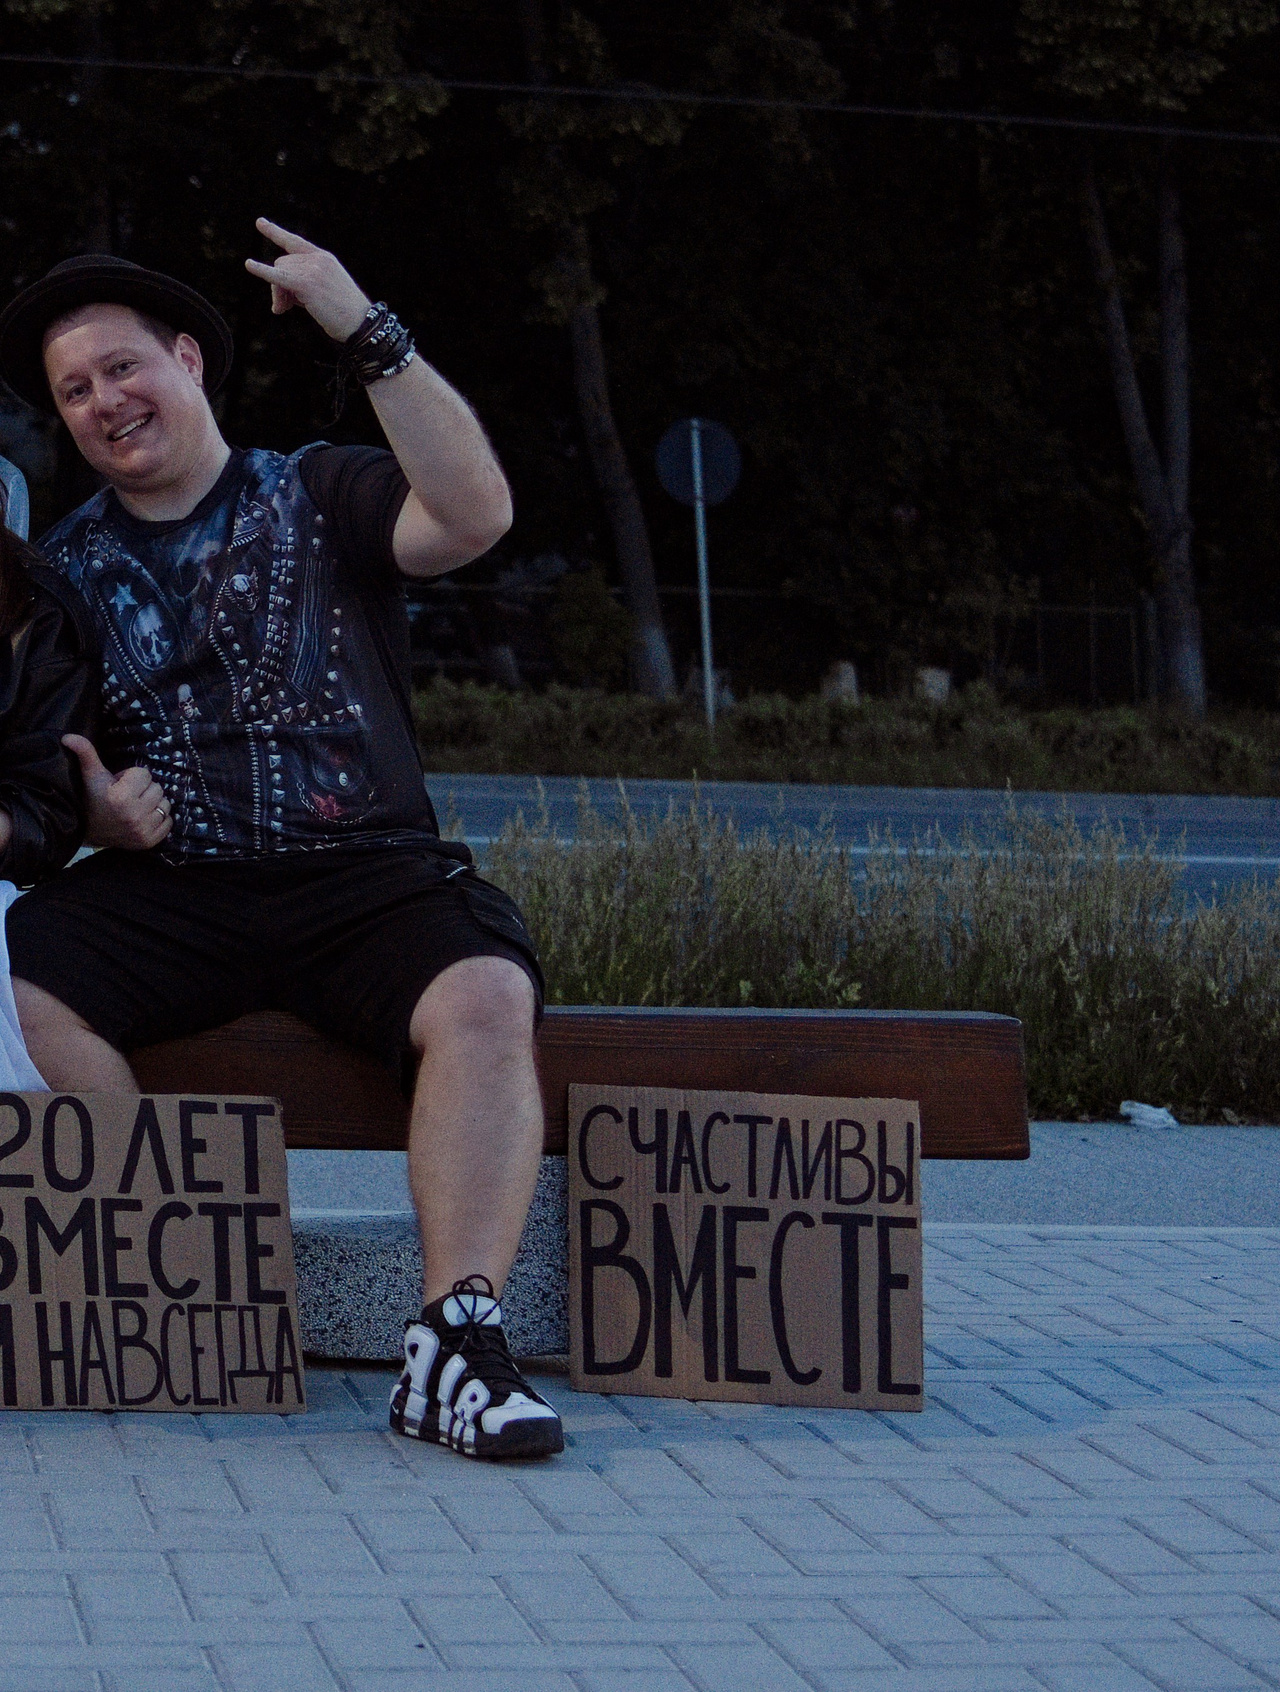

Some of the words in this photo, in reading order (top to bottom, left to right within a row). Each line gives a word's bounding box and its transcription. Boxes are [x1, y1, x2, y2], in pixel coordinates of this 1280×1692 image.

[118, 1098, 275, 1195] ЛЕТ
[578, 1104, 915, 1205] СЧАСТЛИВЫ
[580, 1199, 920, 1395] ВМЕСТЕ
[34, 1300, 304, 1406] НАВСЕГДА
